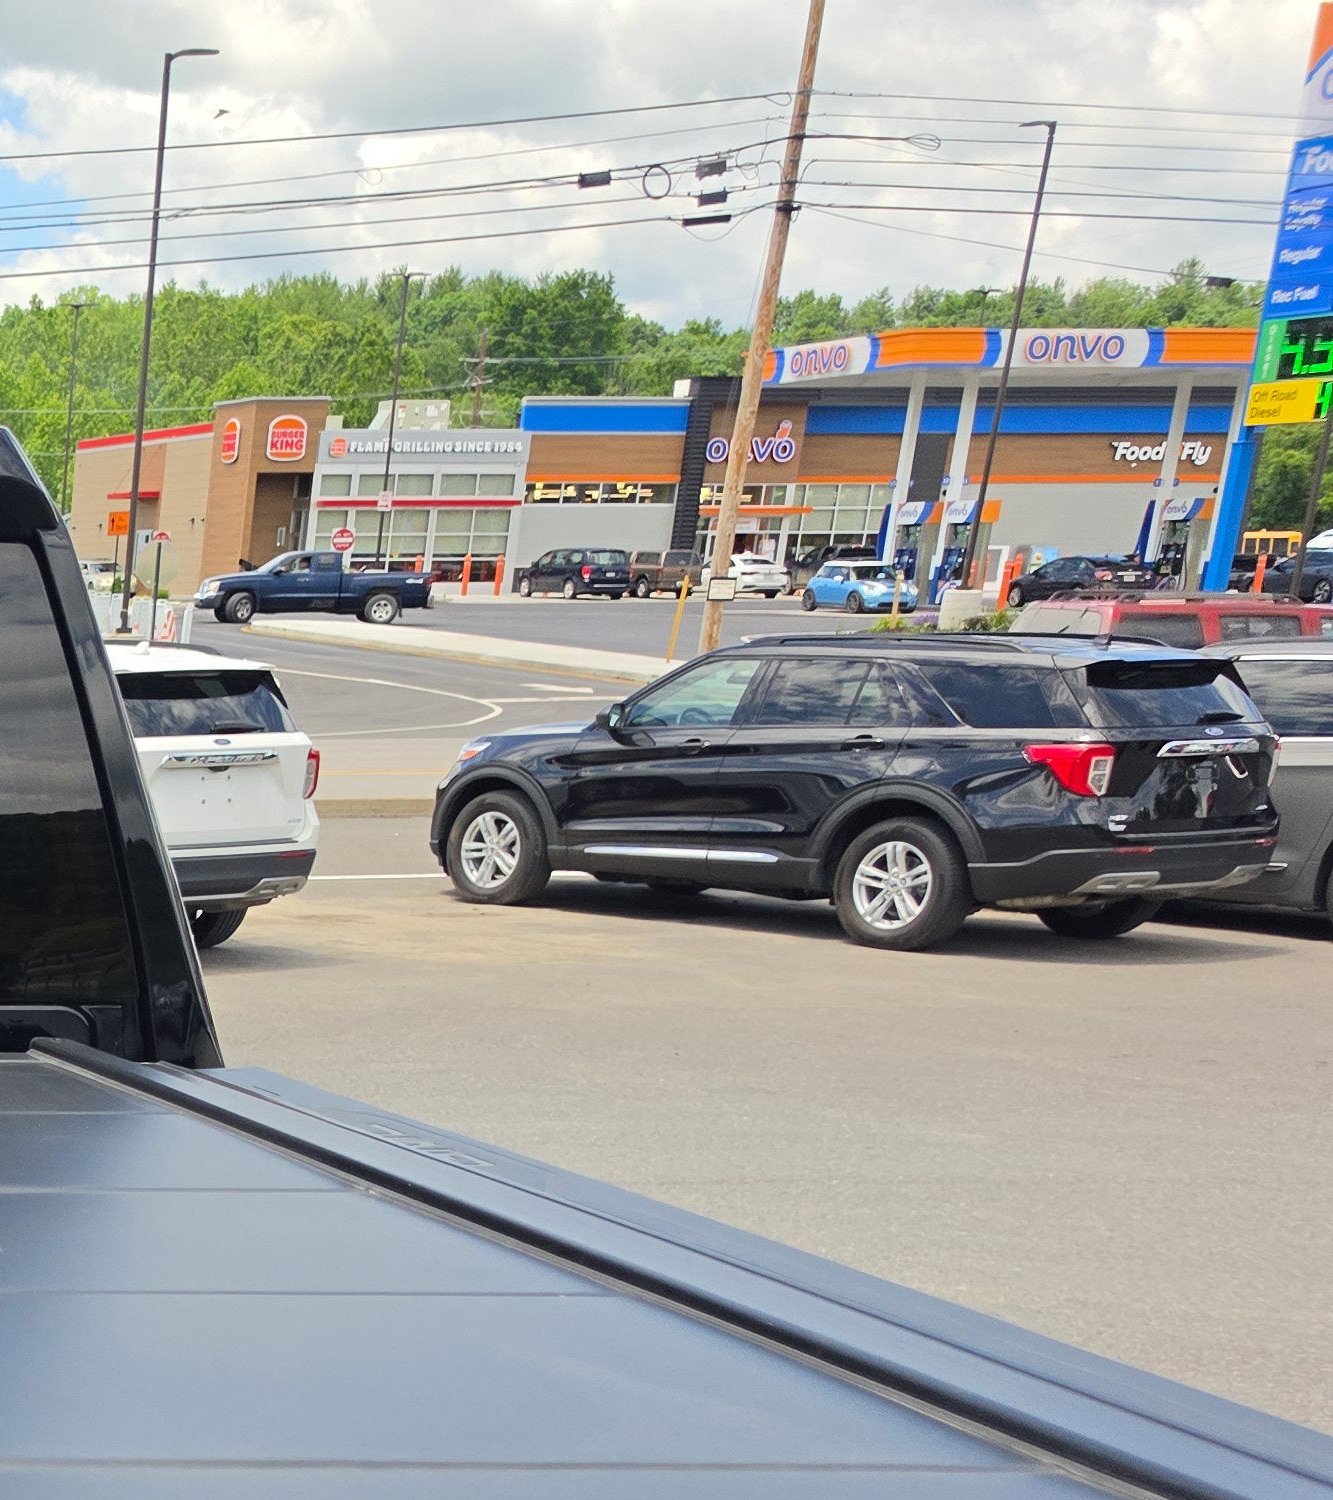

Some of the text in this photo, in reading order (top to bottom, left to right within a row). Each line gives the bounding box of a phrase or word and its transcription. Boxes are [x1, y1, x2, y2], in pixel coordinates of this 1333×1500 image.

[1278, 245, 1324, 265] Regular
[1027, 334, 1126, 361] onvo
[790, 345, 849, 375] onvo
[1270, 388, 1299, 402] Road
[1249, 404, 1282, 419] Diesel
[271, 430, 305, 439] BURGER
[269, 439, 304, 451] KING
[394, 441, 453, 453] GRILLING
[453, 441, 493, 453] SINCE
[706, 437, 795, 462] ovo
[1180, 440, 1212, 465] Fly
